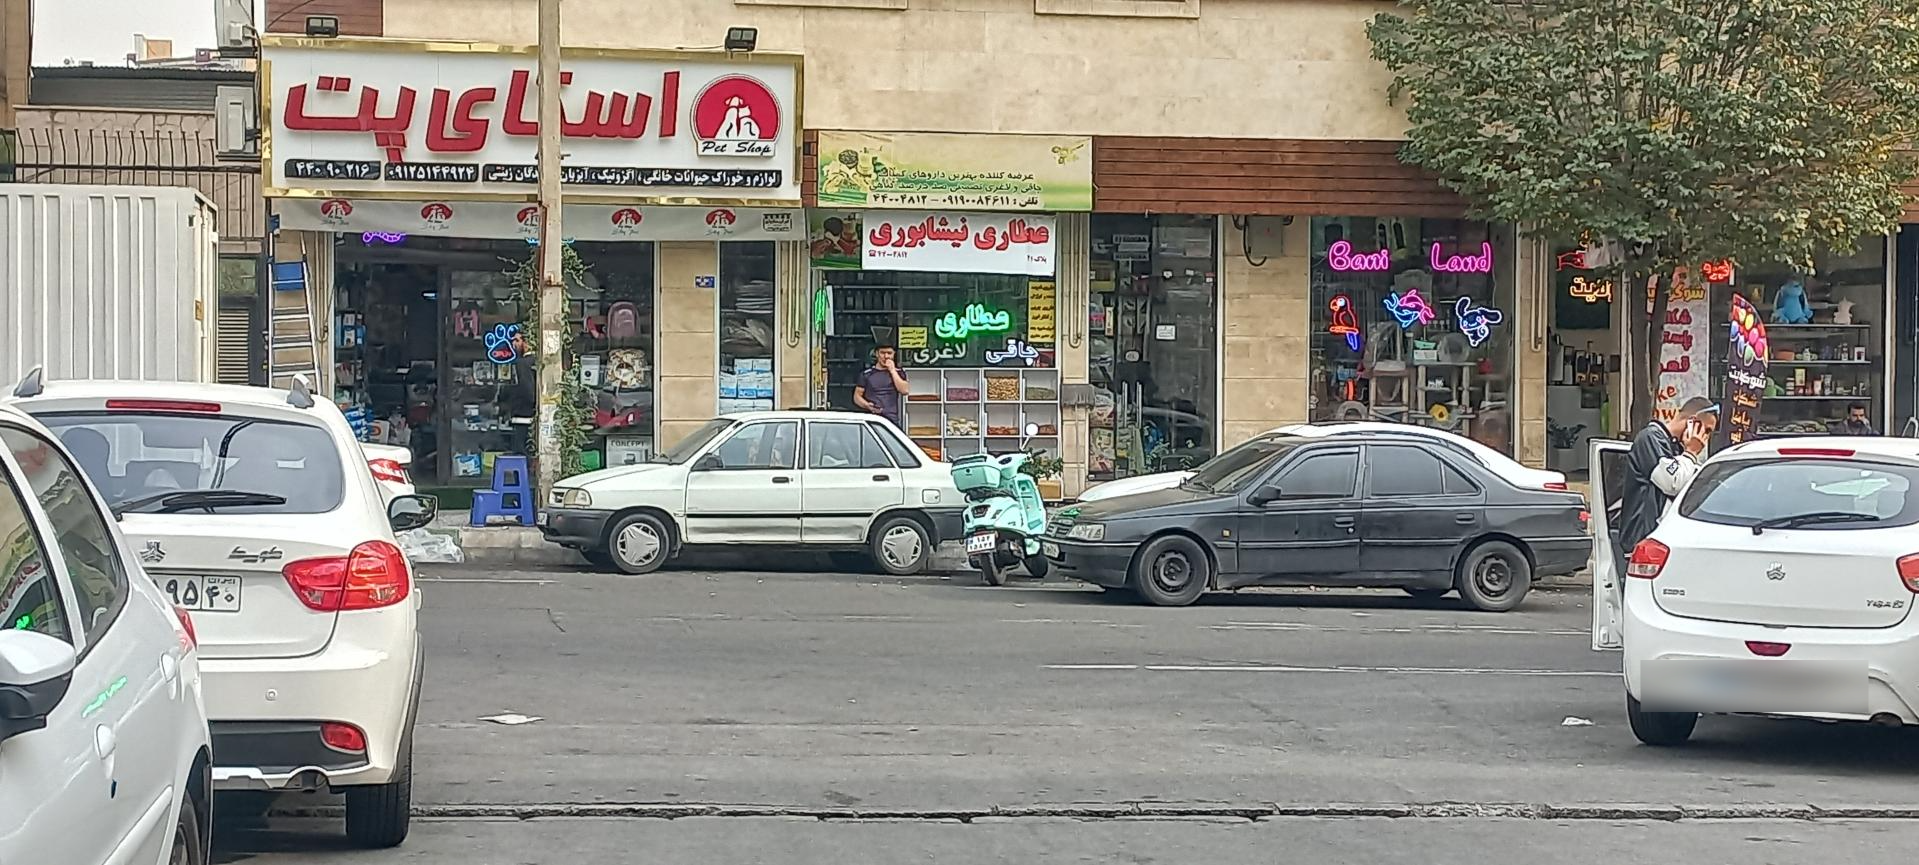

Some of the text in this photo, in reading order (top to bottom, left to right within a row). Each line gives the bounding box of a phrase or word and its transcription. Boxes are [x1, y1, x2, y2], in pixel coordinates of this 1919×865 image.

[283, 75, 417, 162] پت
[702, 141, 772, 156] Pet Shop
[295, 162, 370, 177] ۴۴۰ ۹۰ ۲۱۶
[561, 167, 589, 183] آبزیان
[908, 170, 945, 180] داروهای
[948, 171, 977, 182] بهترین
[980, 171, 1005, 179] کننده
[674, 170, 710, 186] حیوانات
[711, 171, 744, 185] خوراک
[746, 176, 752, 186] و
[753, 172, 777, 186] لوازم
[1007, 172, 1034, 182] عرضه
[917, 183, 929, 192] در
[985, 182, 1013, 193] لاغری
[872, 194, 928, 206] ۴۴۰۰۴۸۱۲
[869, 215, 1050, 251] عطاری نیشابوری
[1328, 240, 1492, 272] Bani Land
[935, 303, 1010, 338] عطاری
[913, 338, 1040, 365] چاقی لاغری
[153, 579, 199, 606] ۹۵
